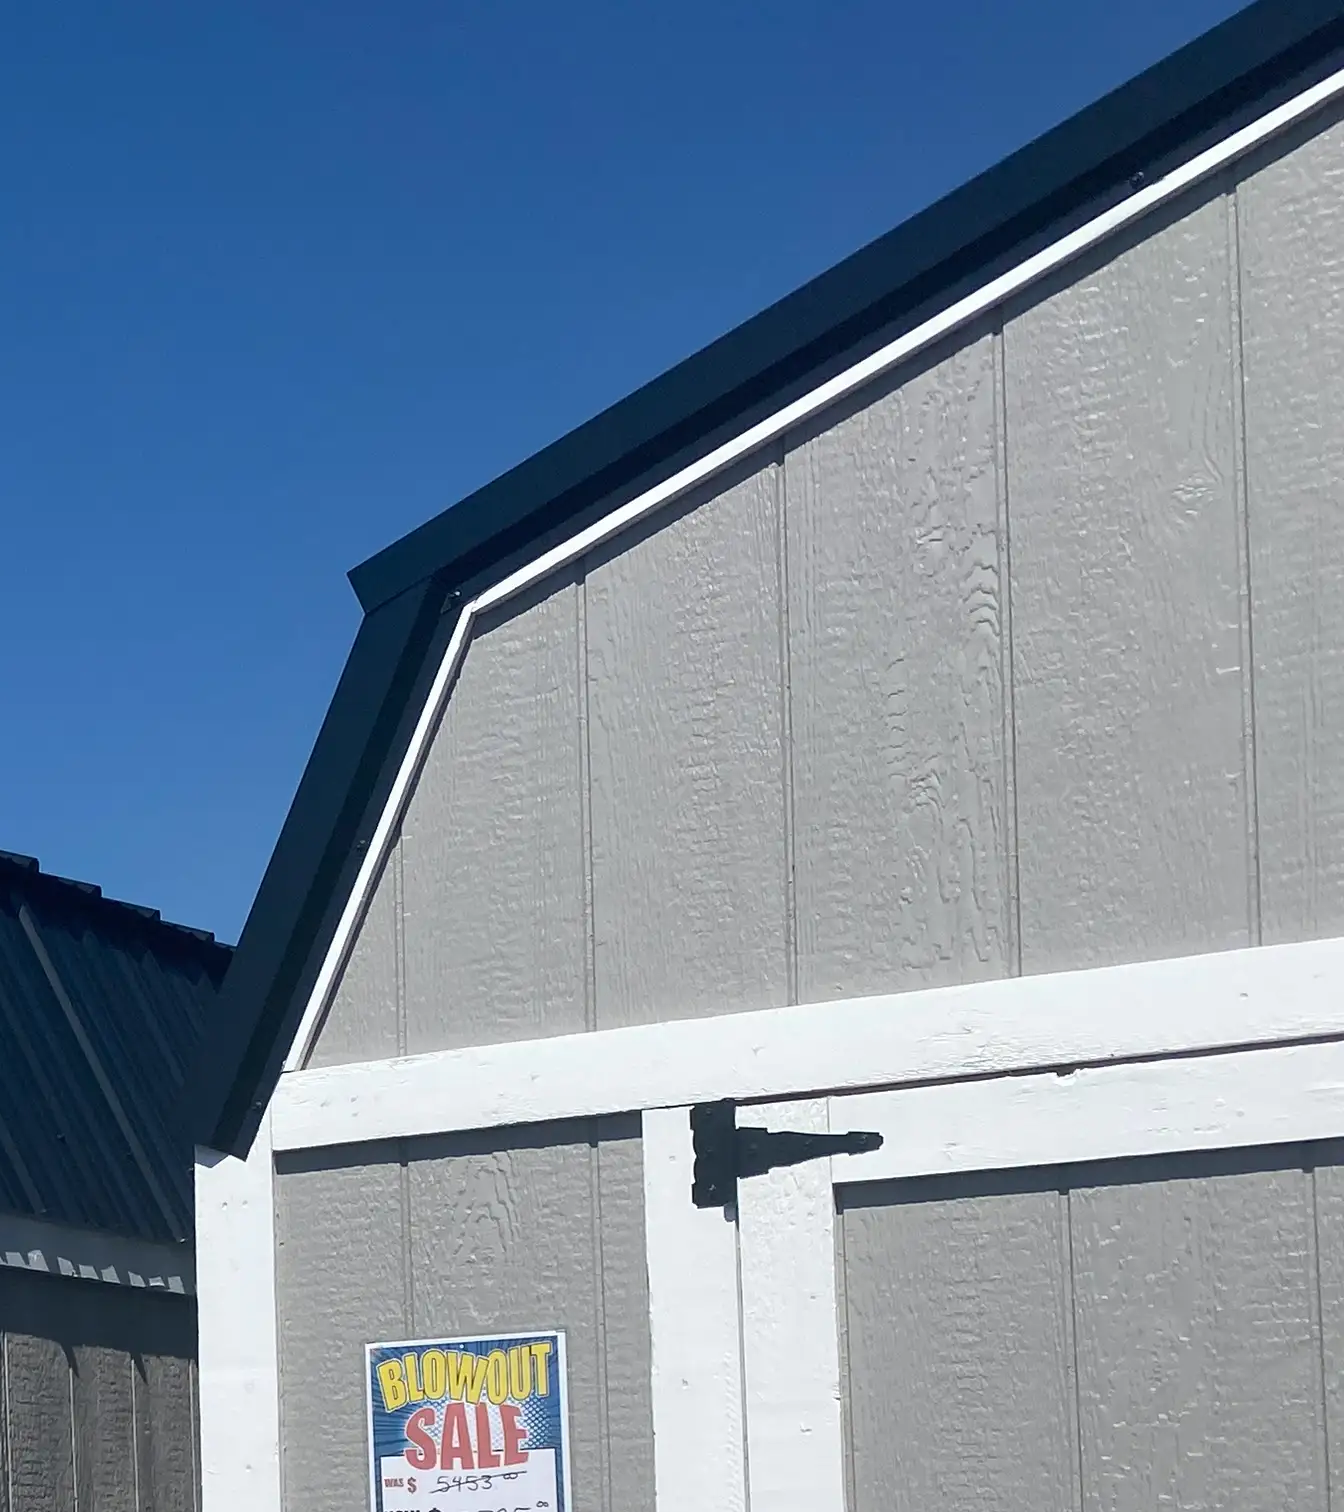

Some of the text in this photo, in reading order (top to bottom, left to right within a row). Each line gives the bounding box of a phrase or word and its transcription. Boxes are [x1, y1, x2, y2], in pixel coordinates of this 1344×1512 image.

[377, 1342, 552, 1412] BLOWOUT
[404, 1402, 529, 1470] SALE
[384, 1478, 404, 1488] WAS
[407, 1477, 417, 1494] $
[435, 1475, 493, 1493] 5453
